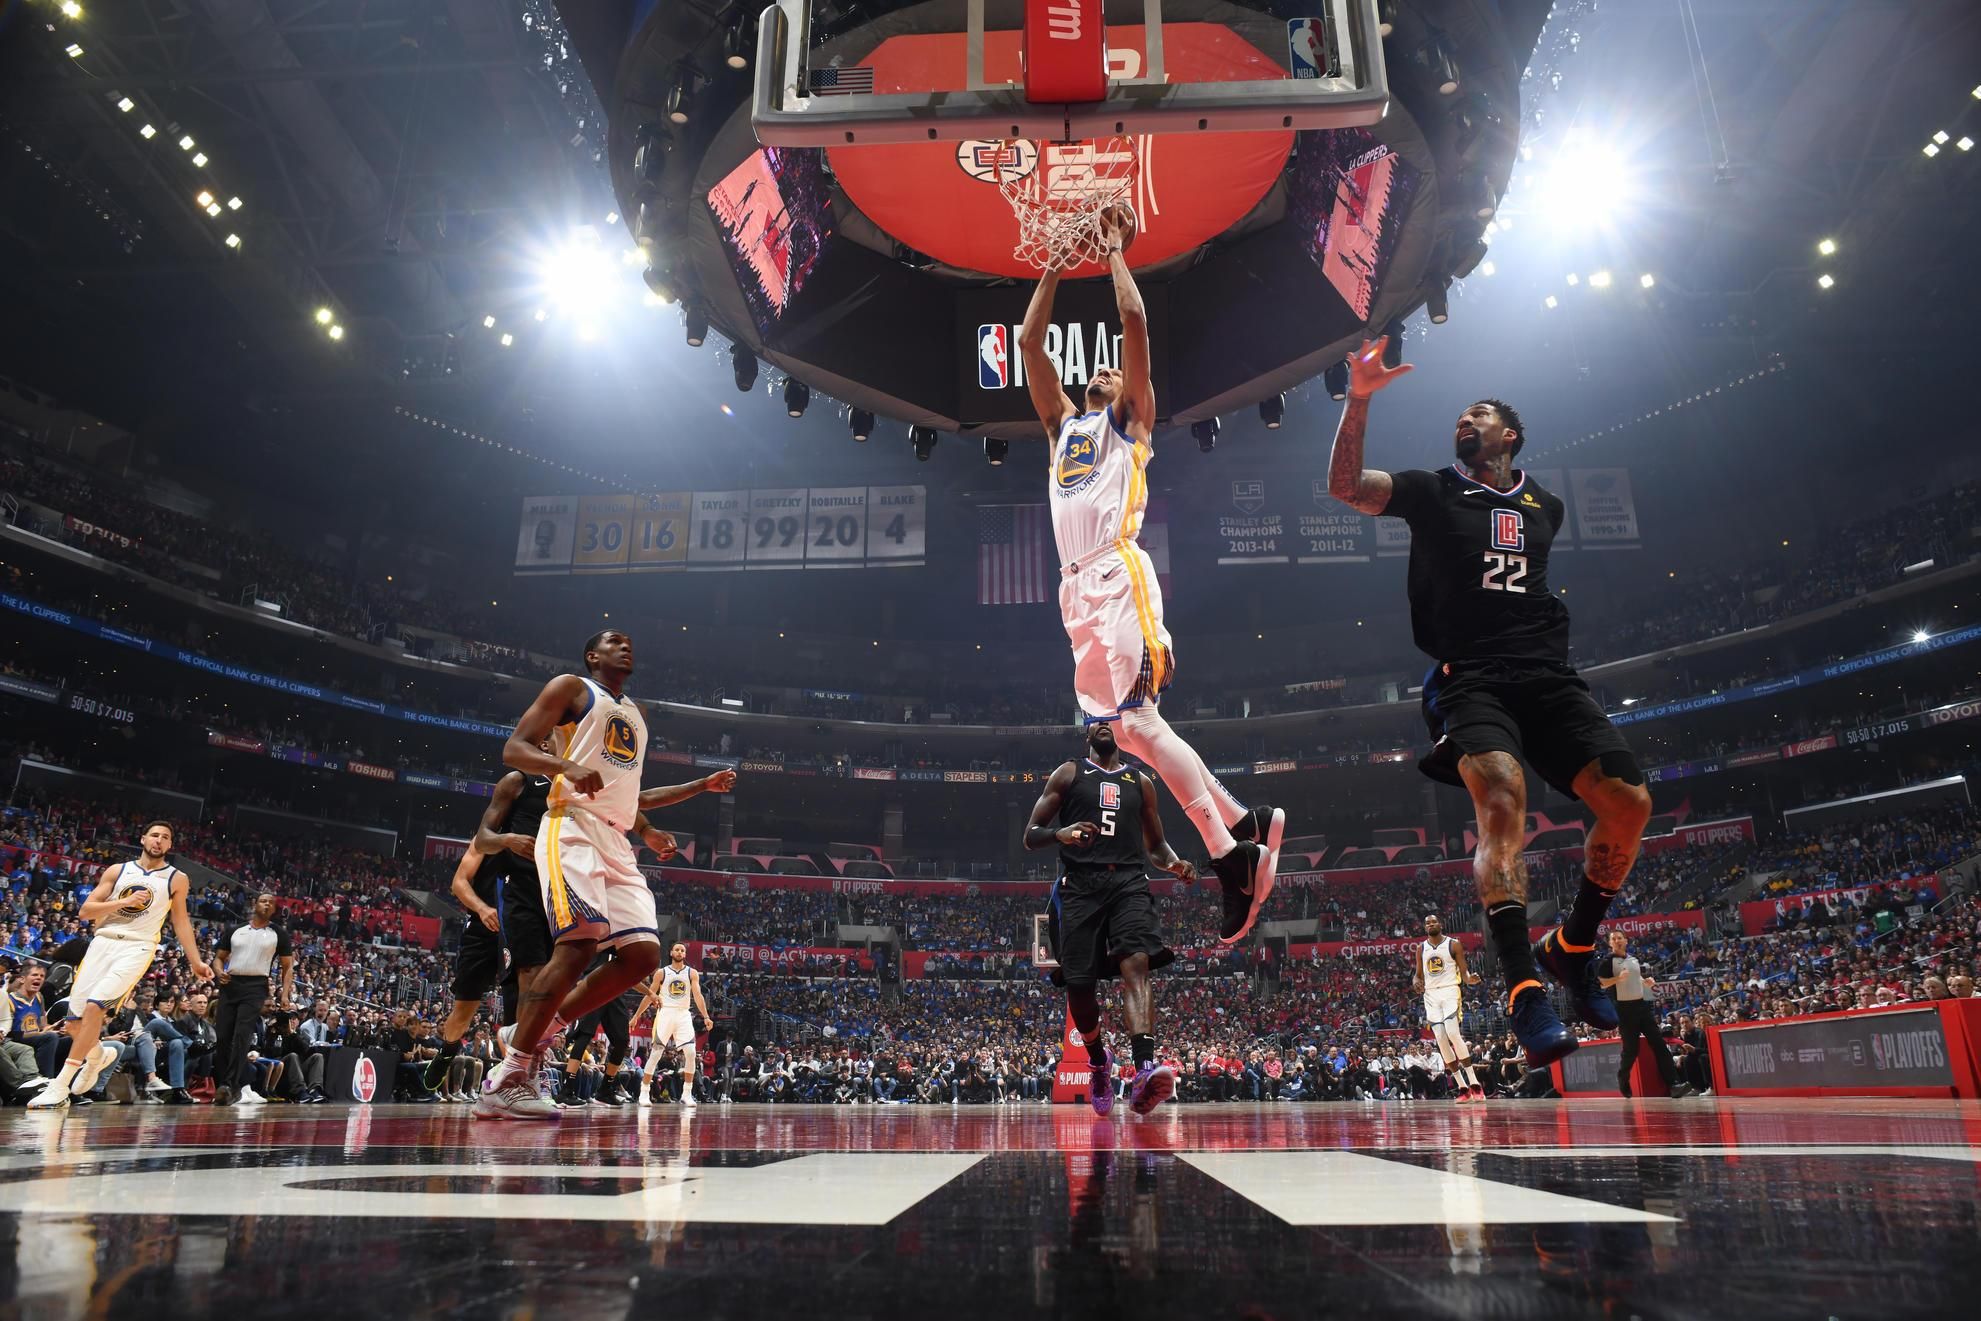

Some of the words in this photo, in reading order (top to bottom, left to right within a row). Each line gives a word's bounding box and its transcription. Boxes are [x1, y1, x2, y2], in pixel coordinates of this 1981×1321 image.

[1296, 68, 1315, 79] NBA
[1357, 144, 1388, 167] CLIPPERS
[1070, 440, 1092, 458] 34
[700, 500, 738, 510] TAYLOR
[754, 497, 801, 508] GRETZKY
[811, 496, 864, 507] ROBITAILLE
[880, 495, 915, 505] BLAKE
[530, 505, 568, 514] MILLER
[1220, 516, 1259, 526] STANLEY
[1262, 515, 1281, 525] CUP
[1299, 516, 1340, 526] STANLEY
[1342, 515, 1361, 524] CUP
[642, 519, 676, 551] 16
[700, 518, 734, 549] 18
[754, 515, 799, 547] 99
[814, 515, 859, 546] 20
[885, 513, 906, 544] 4
[1220, 525, 1283, 536] CHAMPIONS
[1300, 525, 1362, 536] CHAMPIONS
[582, 521, 625, 552] 30
[1229, 540, 1276, 553] 2013-14
[1310, 539, 1355, 552] 2011-12
[1482, 551, 1527, 593] 22
[19, 602, 30, 612] LA
[33, 606, 71, 625] CLIPPERS
[1824, 667, 1838, 677] THE
[1840, 659, 1873, 673] OFFICIAL
[1875, 650, 1899, 663] BANK
[1901, 647, 1912, 656] OF
[1932, 639, 1945, 648] LA
[178, 651, 192, 665] THE
[193, 657, 223, 673] OFFICIAL
[226, 666, 249, 680] BANK
[250, 673, 262, 683] OF
[263, 675, 277, 686] THE
[278, 678, 288, 688] LA
[289, 683, 321, 697] CLIPPERS
[71, 695, 96, 713] 50-50
[1693, 696, 1726, 708] CLIPPERS
[1929, 701, 1981, 724] TOYOT
[404, 711, 417, 721] THE
[418, 714, 448, 726] OFFICIAL
[449, 720, 470, 730] BANK
[483, 726, 495, 735] THE
[496, 728, 505, 737] LA
[623, 726, 630, 741] 5
[1847, 727, 1870, 744] 50-50
[323, 761, 338, 770] MLB
[601, 748, 639, 771] WARRIORS
[349, 762, 396, 780] TOSHIBA
[753, 764, 783, 772] TOYOTA
[1254, 762, 1296, 773] TOSHIBA
[406, 775, 421, 783] BUD
[421, 777, 441, 786] LIGHT
[910, 772, 941, 780] DELTA
[945, 772, 986, 782] STAPLES
[1100, 810, 1116, 836] 5
[1341, 941, 1423, 958] CLIPPERS.CO
[1608, 1054, 1622, 1064] ESP
[1735, 1043, 1775, 1074] PLAYOFFS
[1780, 1051, 1794, 1062] abc
[1798, 1049, 1825, 1063] ESPN
[1882, 1030, 1944, 1069] PLAYOFFS
[1065, 1072, 1091, 1085] PLAYOF
